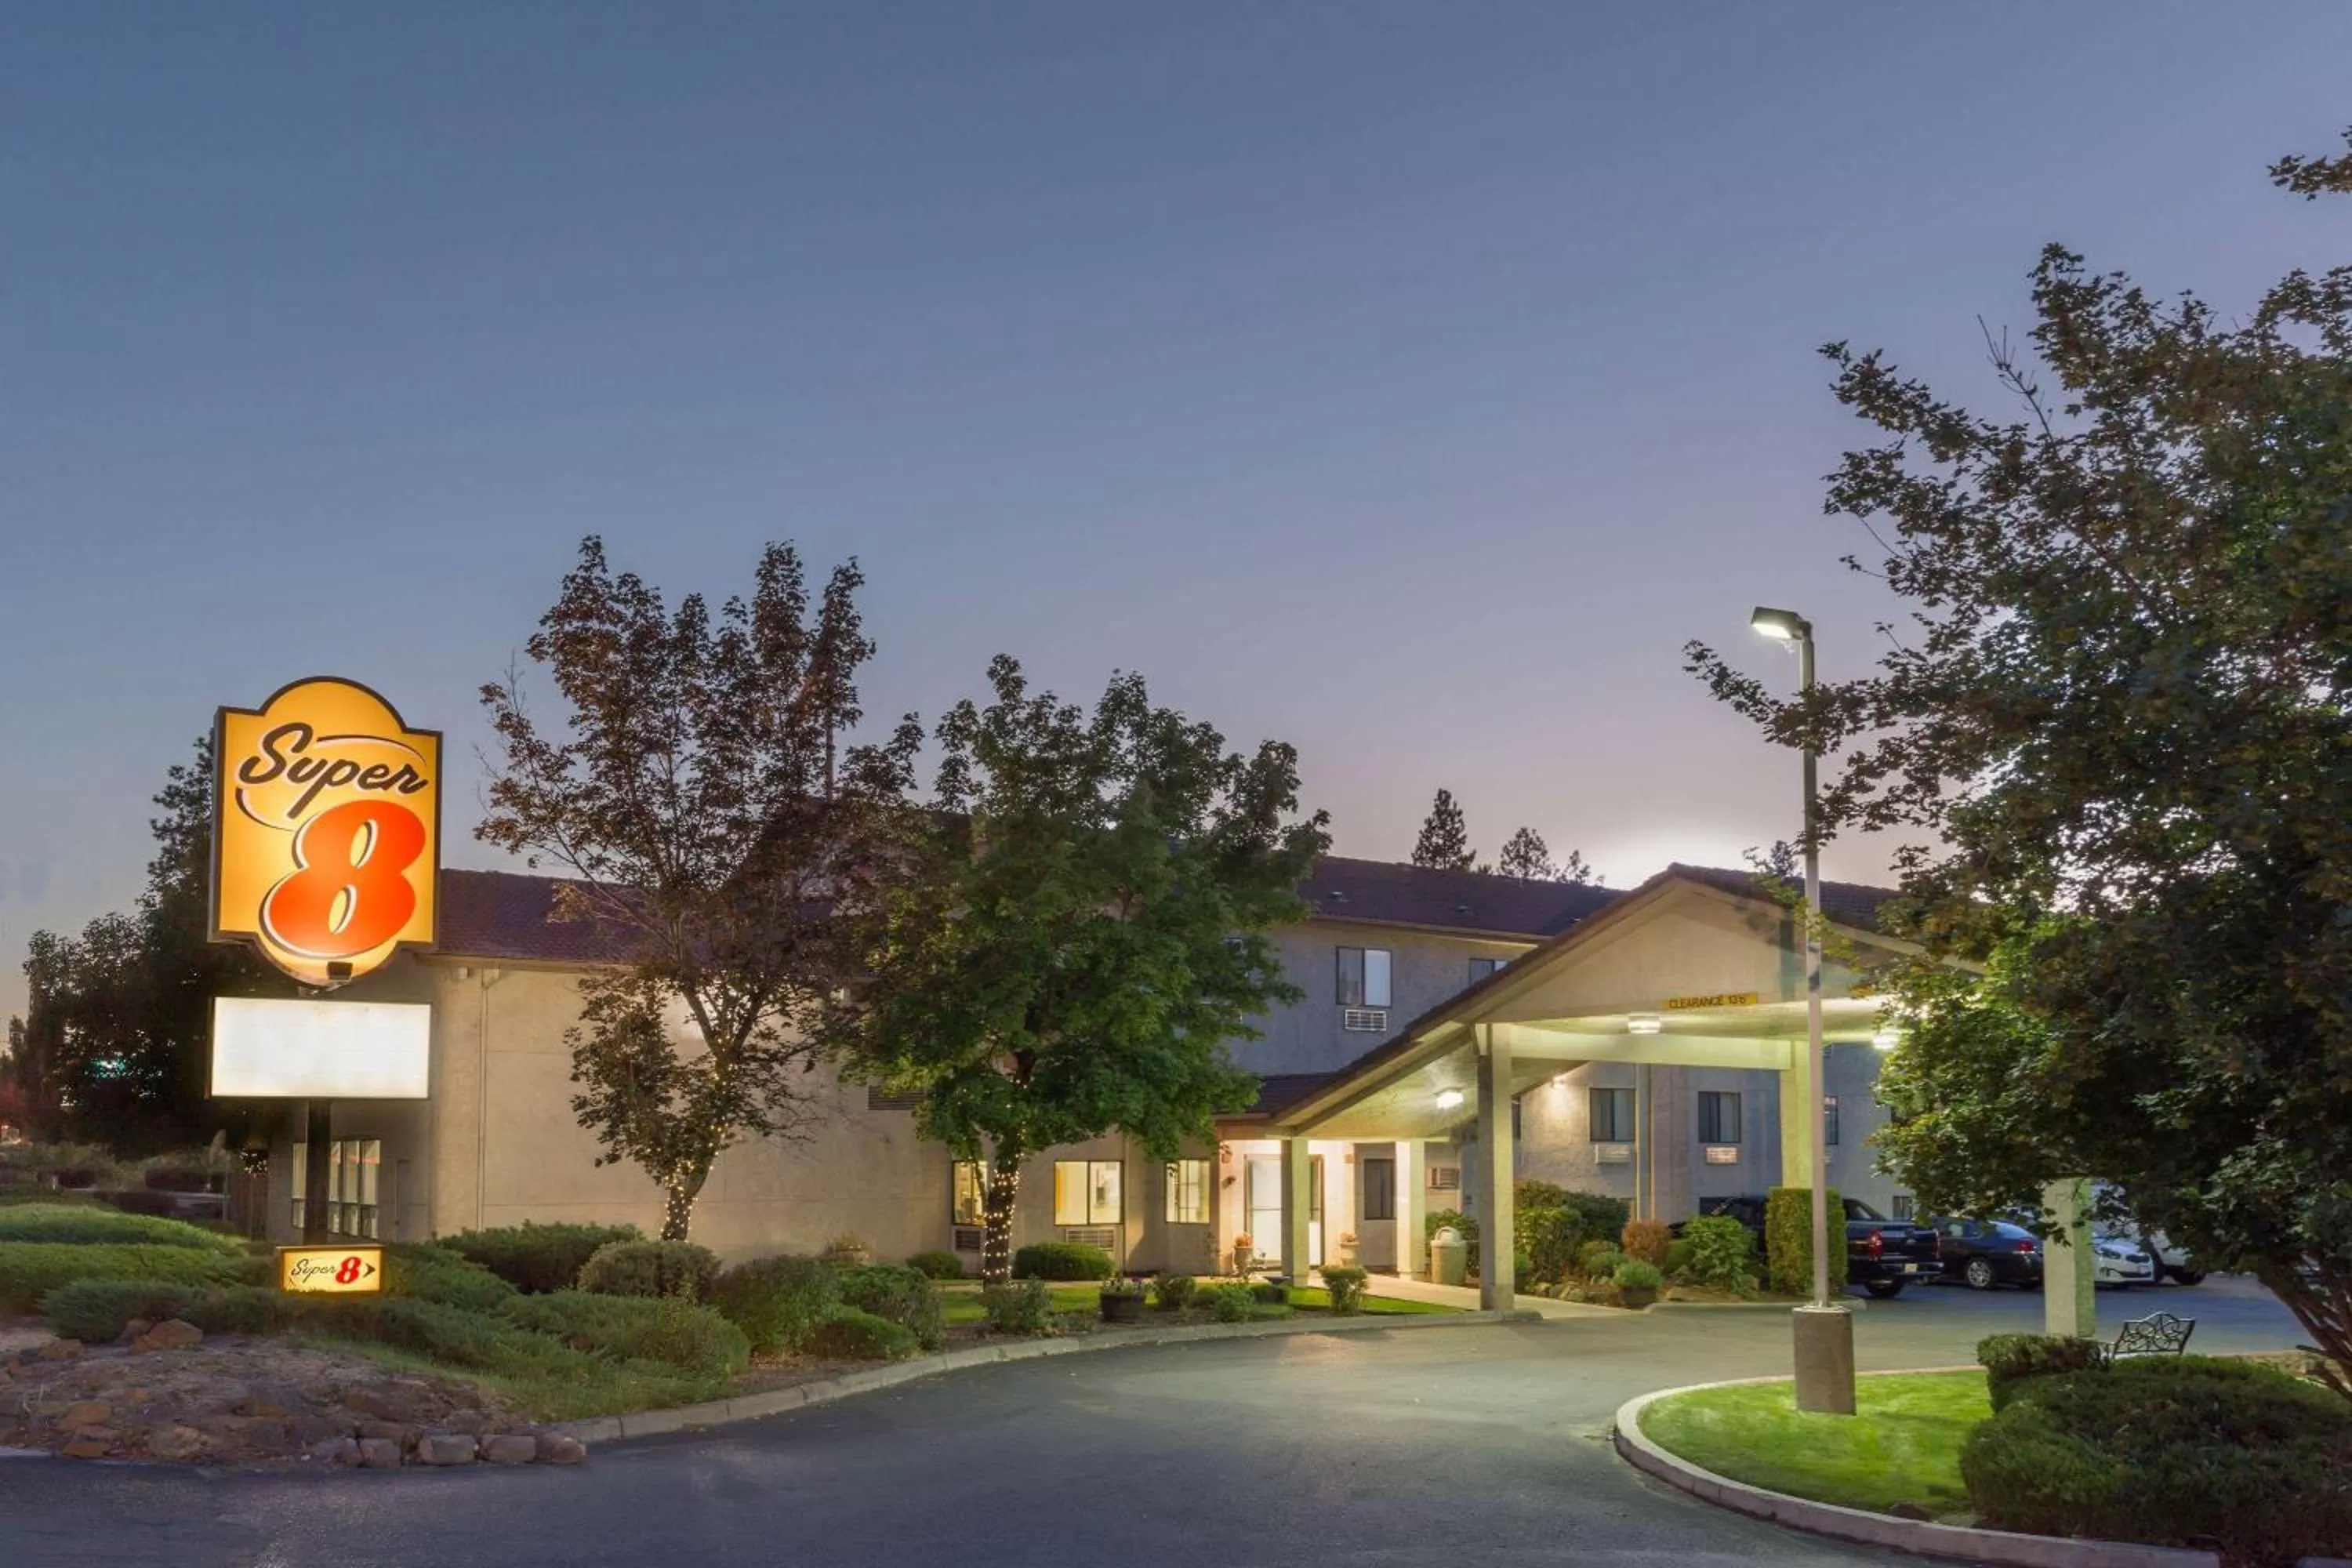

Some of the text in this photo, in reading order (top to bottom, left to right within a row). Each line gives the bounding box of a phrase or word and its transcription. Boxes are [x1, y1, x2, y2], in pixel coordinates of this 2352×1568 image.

[238, 723, 428, 818] Super
[259, 800, 426, 958] 8
[1668, 995, 1724, 1008] CLEARANCE
[292, 1256, 361, 1284] Super 8
